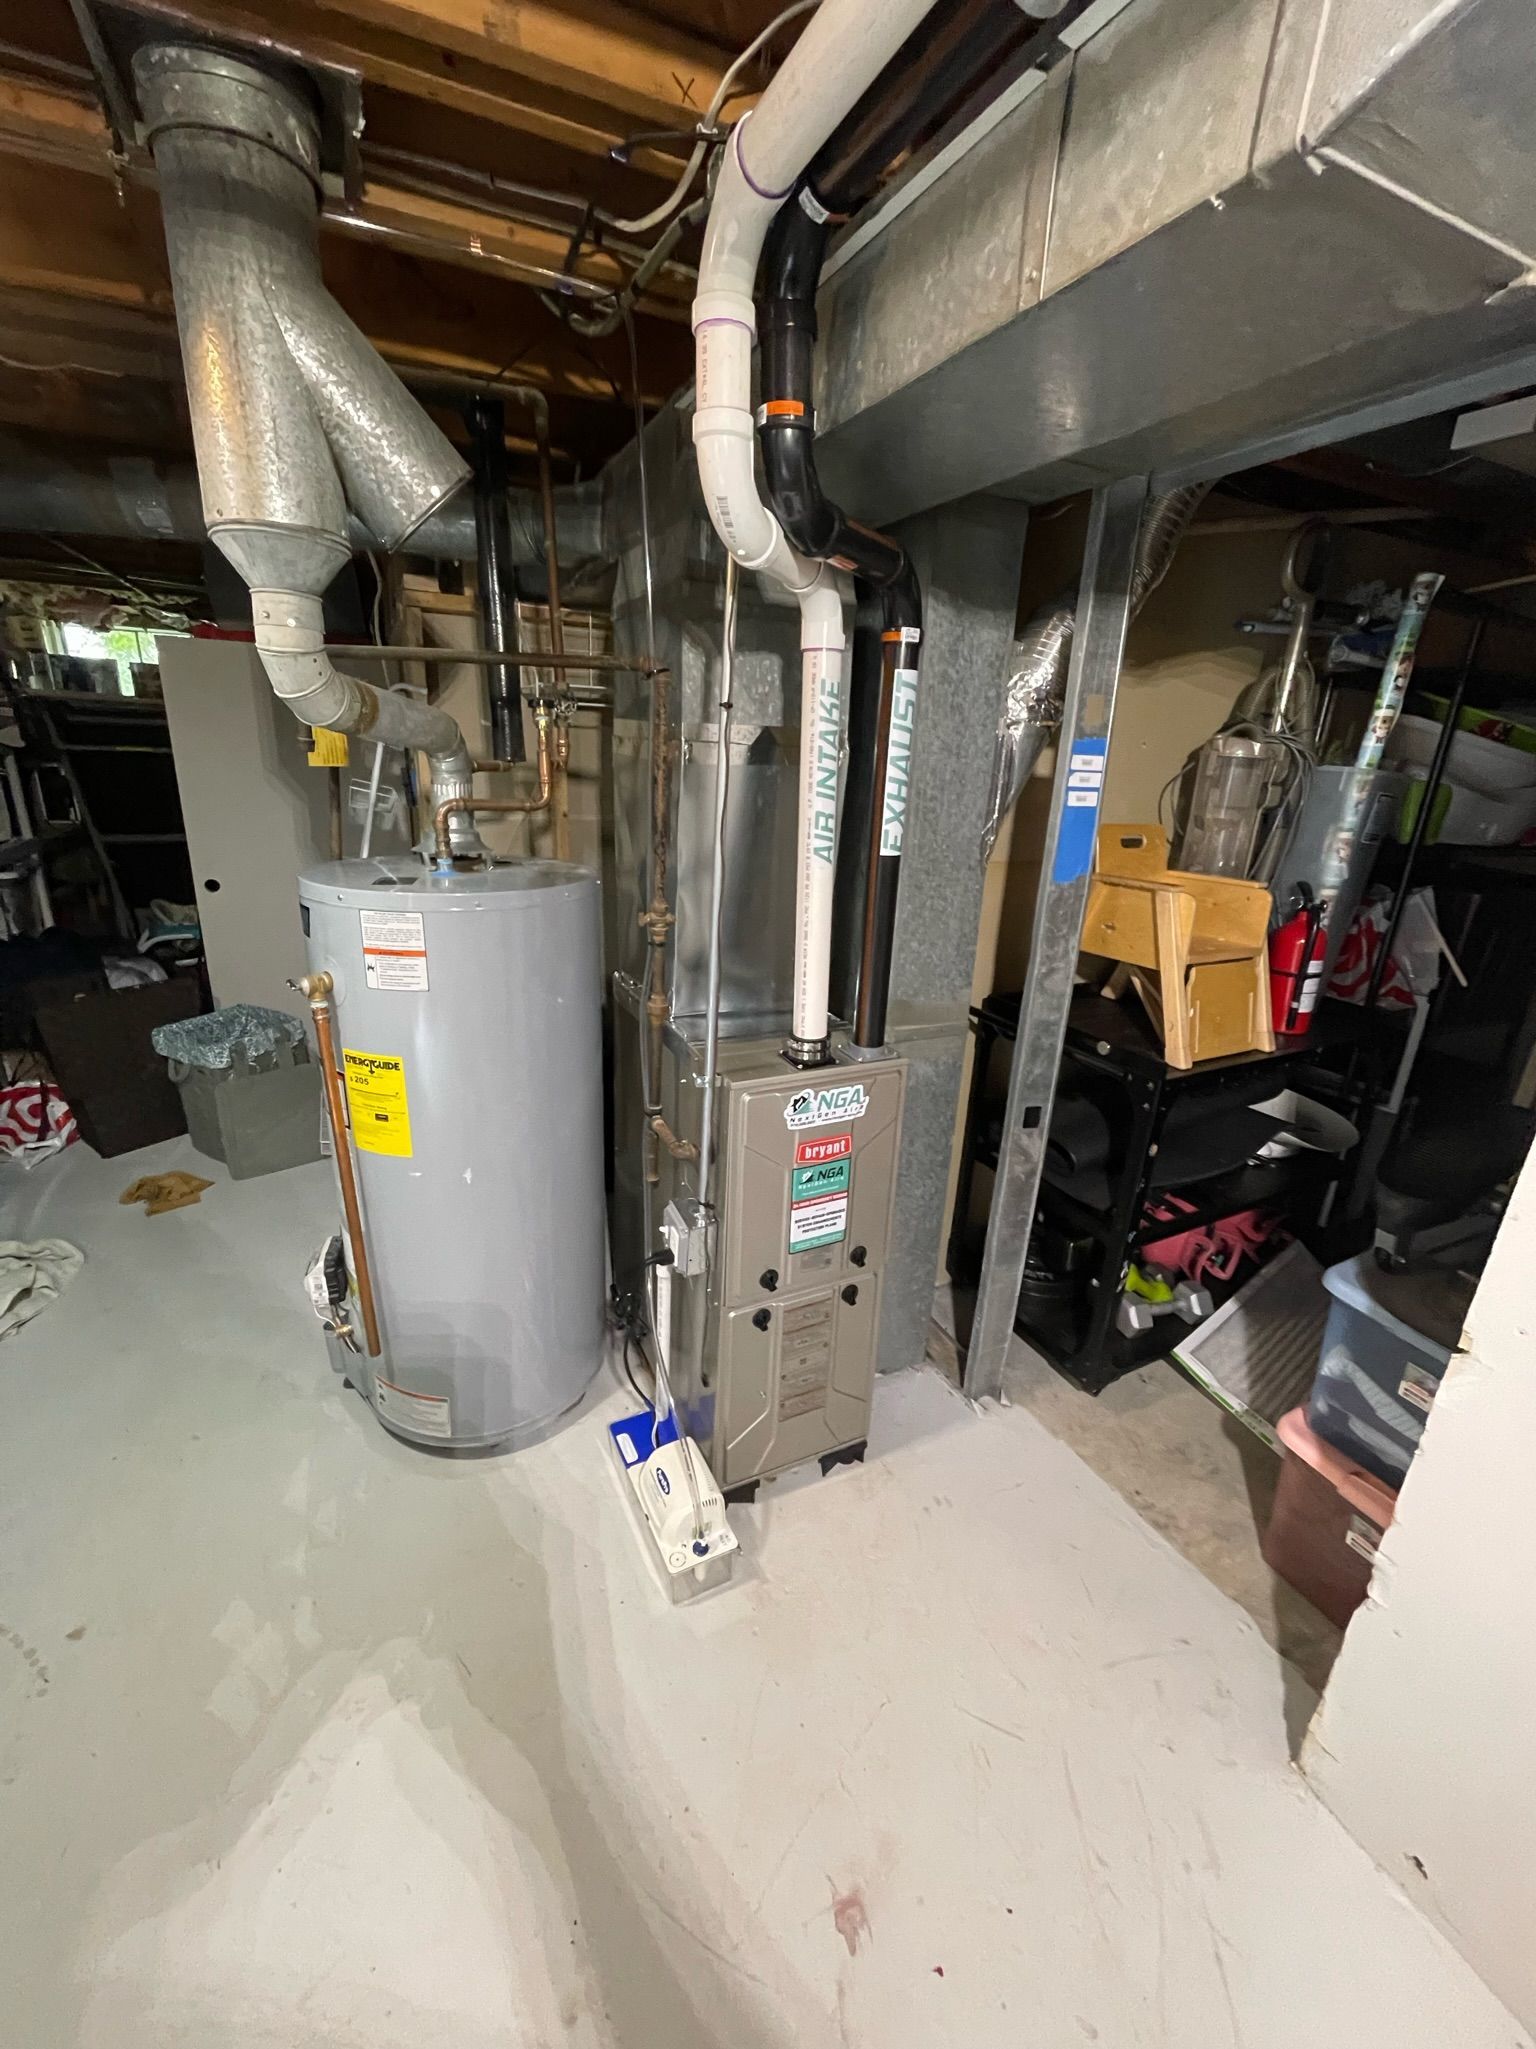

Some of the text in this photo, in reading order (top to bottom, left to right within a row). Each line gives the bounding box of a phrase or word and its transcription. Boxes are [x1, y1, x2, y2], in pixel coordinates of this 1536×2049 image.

[813, 678, 841, 865] AIR INTAKE
[883, 671, 918, 854] EXHAUST
[817, 1087, 862, 1112] NGA
[805, 1140, 846, 1159] bryant
[817, 1166, 844, 1181] NGA
